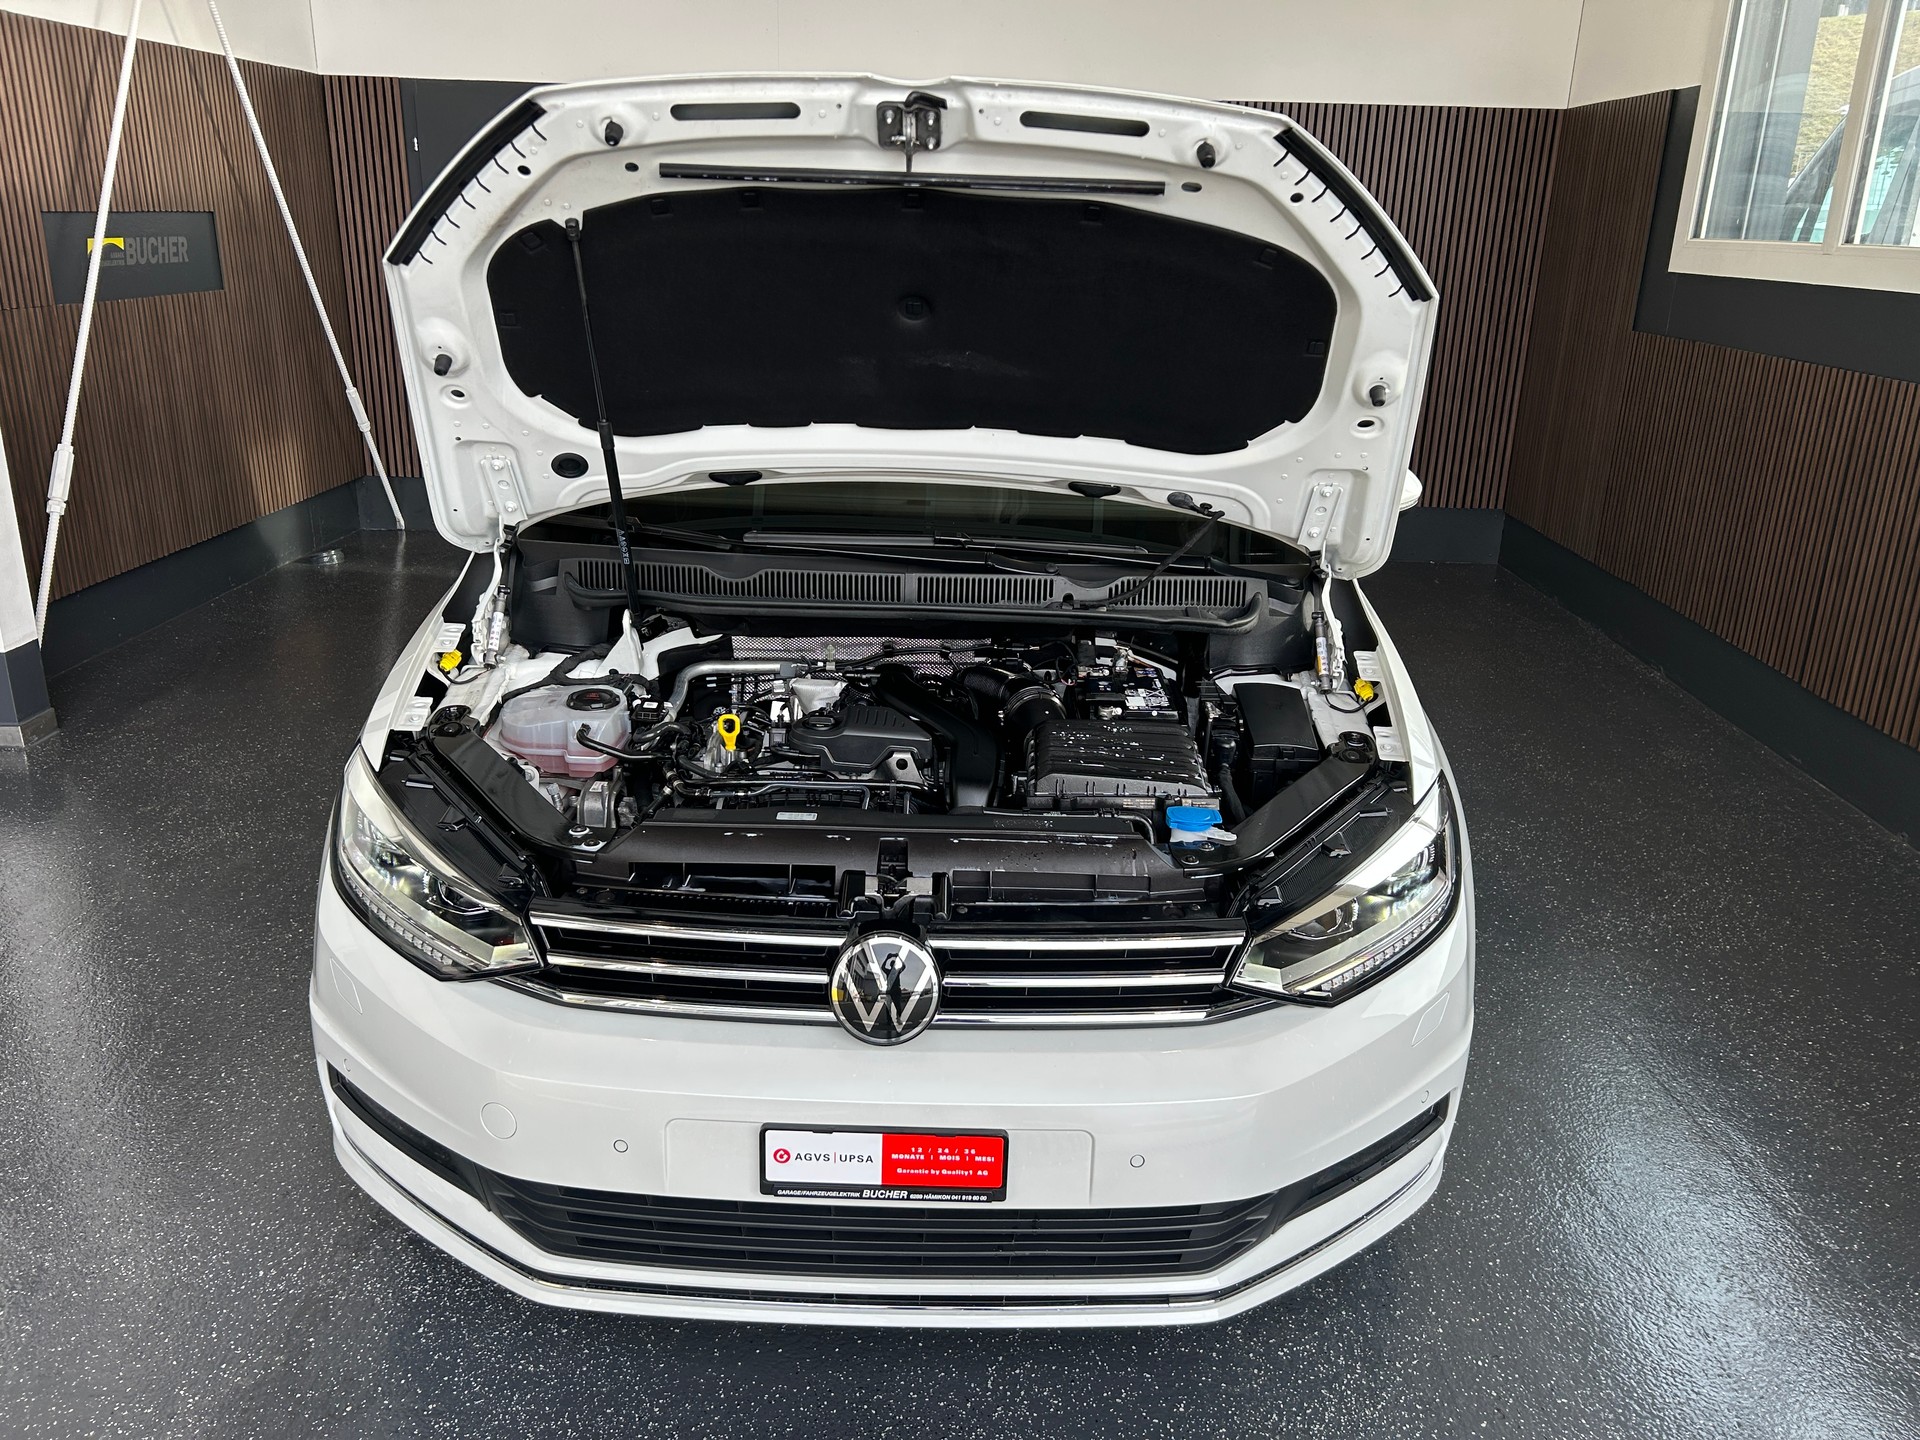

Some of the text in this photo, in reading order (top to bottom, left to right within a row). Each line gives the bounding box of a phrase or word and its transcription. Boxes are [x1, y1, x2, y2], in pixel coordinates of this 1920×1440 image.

[125, 236, 189, 265] BUCHER
[794, 1152, 874, 1163] AGVS UPSA
[941, 1169, 973, 1177] Quality1
[862, 1189, 908, 1199] BUCHER
